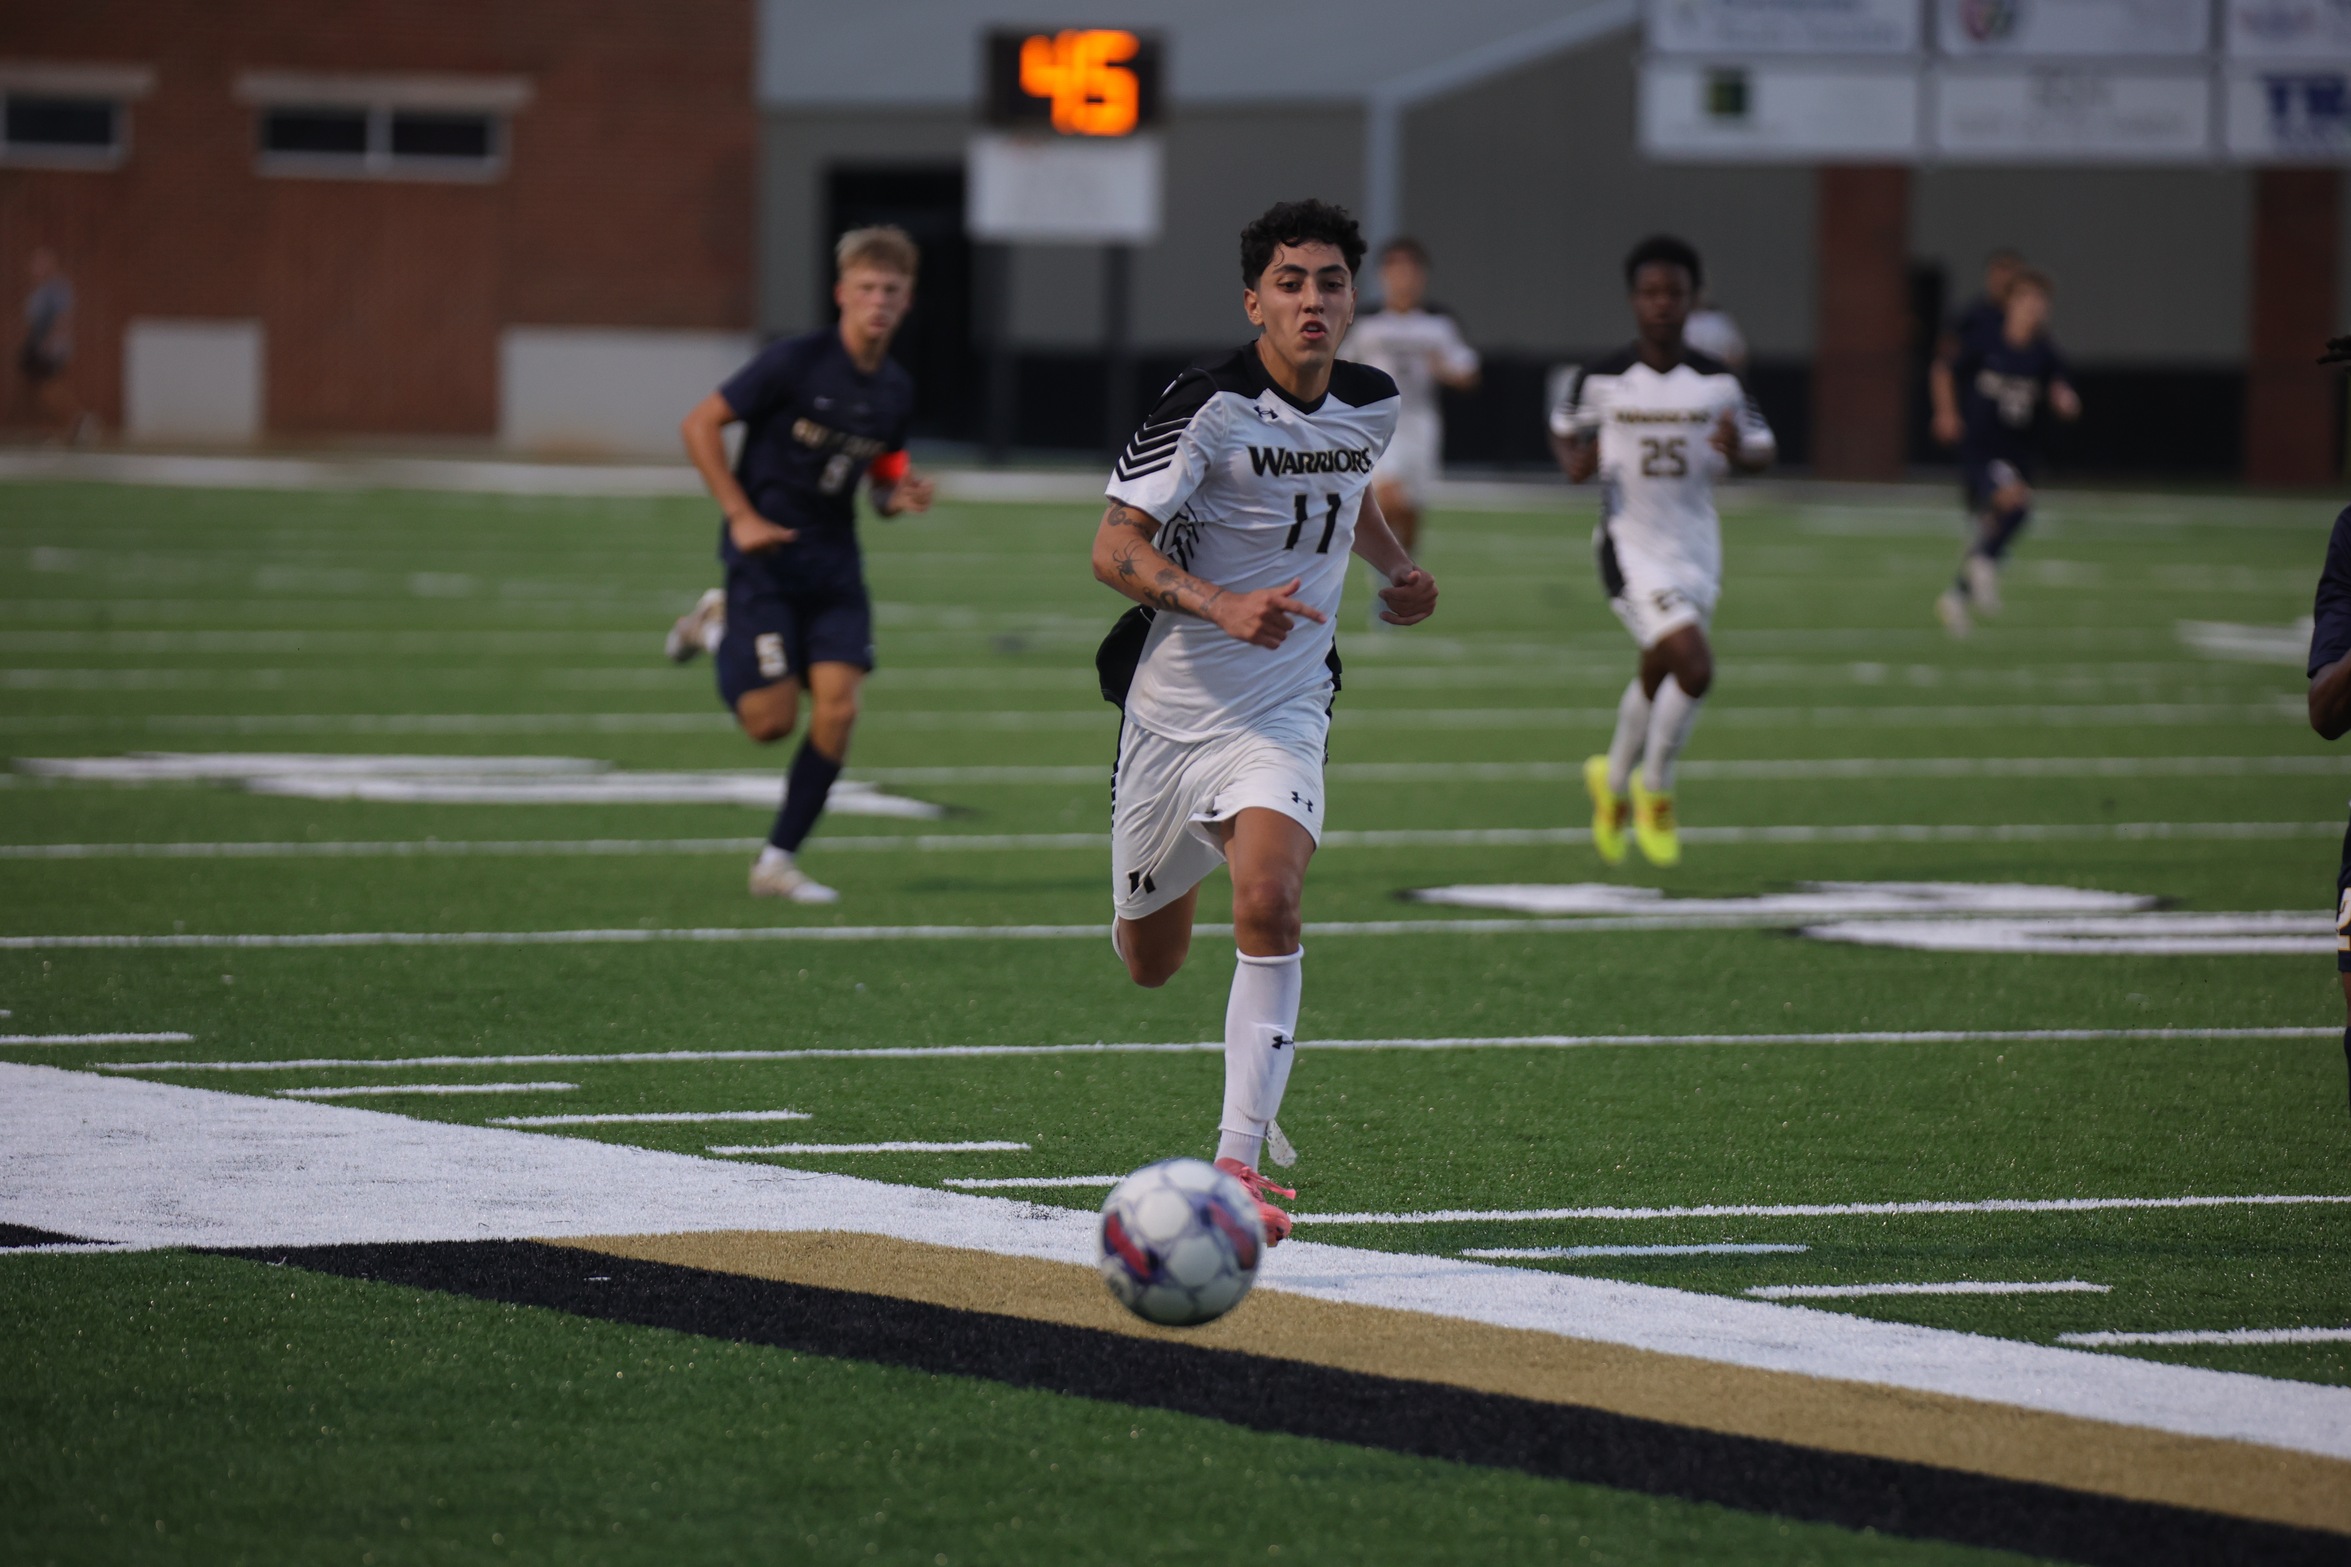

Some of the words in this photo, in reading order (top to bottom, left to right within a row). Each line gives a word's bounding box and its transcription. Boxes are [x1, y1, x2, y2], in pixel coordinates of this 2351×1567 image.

[1247, 445, 1372, 477] WARRIORS
[1640, 437, 1688, 476] 25
[1283, 493, 1341, 554] 11
